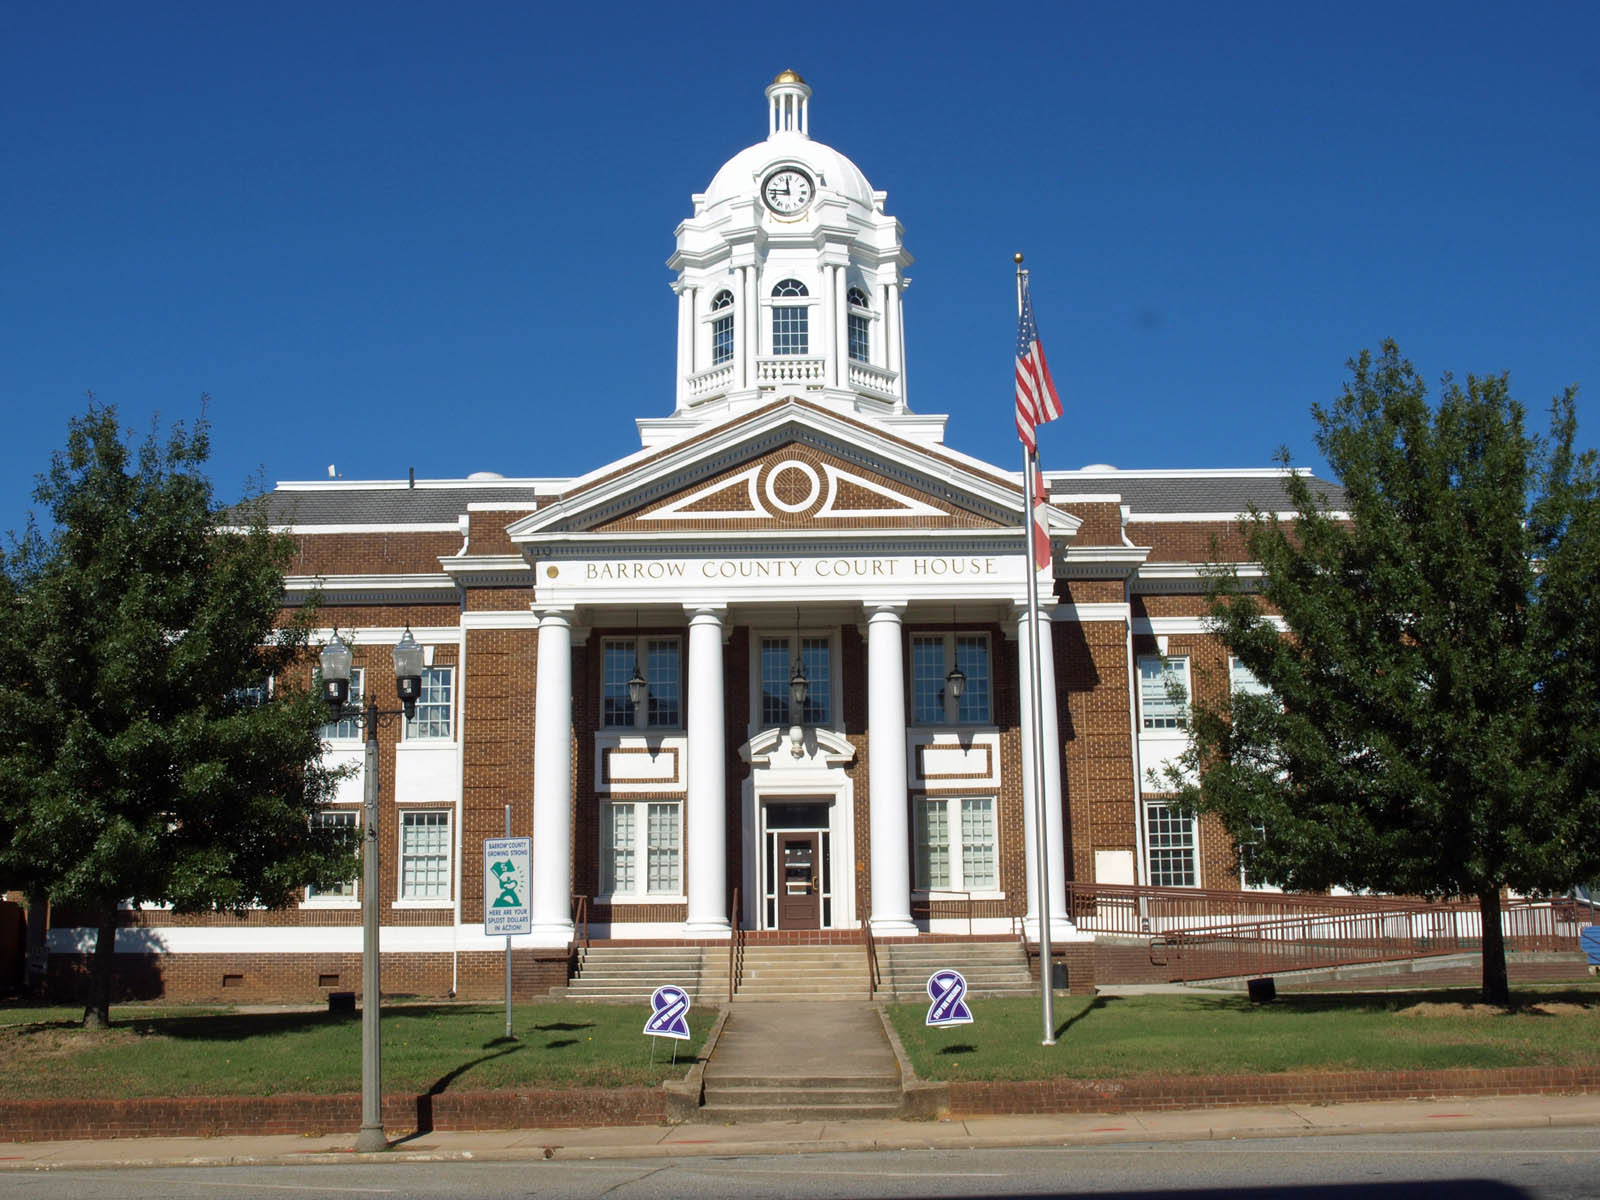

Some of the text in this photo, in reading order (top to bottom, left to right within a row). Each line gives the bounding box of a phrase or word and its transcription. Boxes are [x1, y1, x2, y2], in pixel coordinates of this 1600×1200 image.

[586, 558, 998, 579] BARROW COUNTY COURT HOUSE
[508, 841, 526, 849] COUNTY
